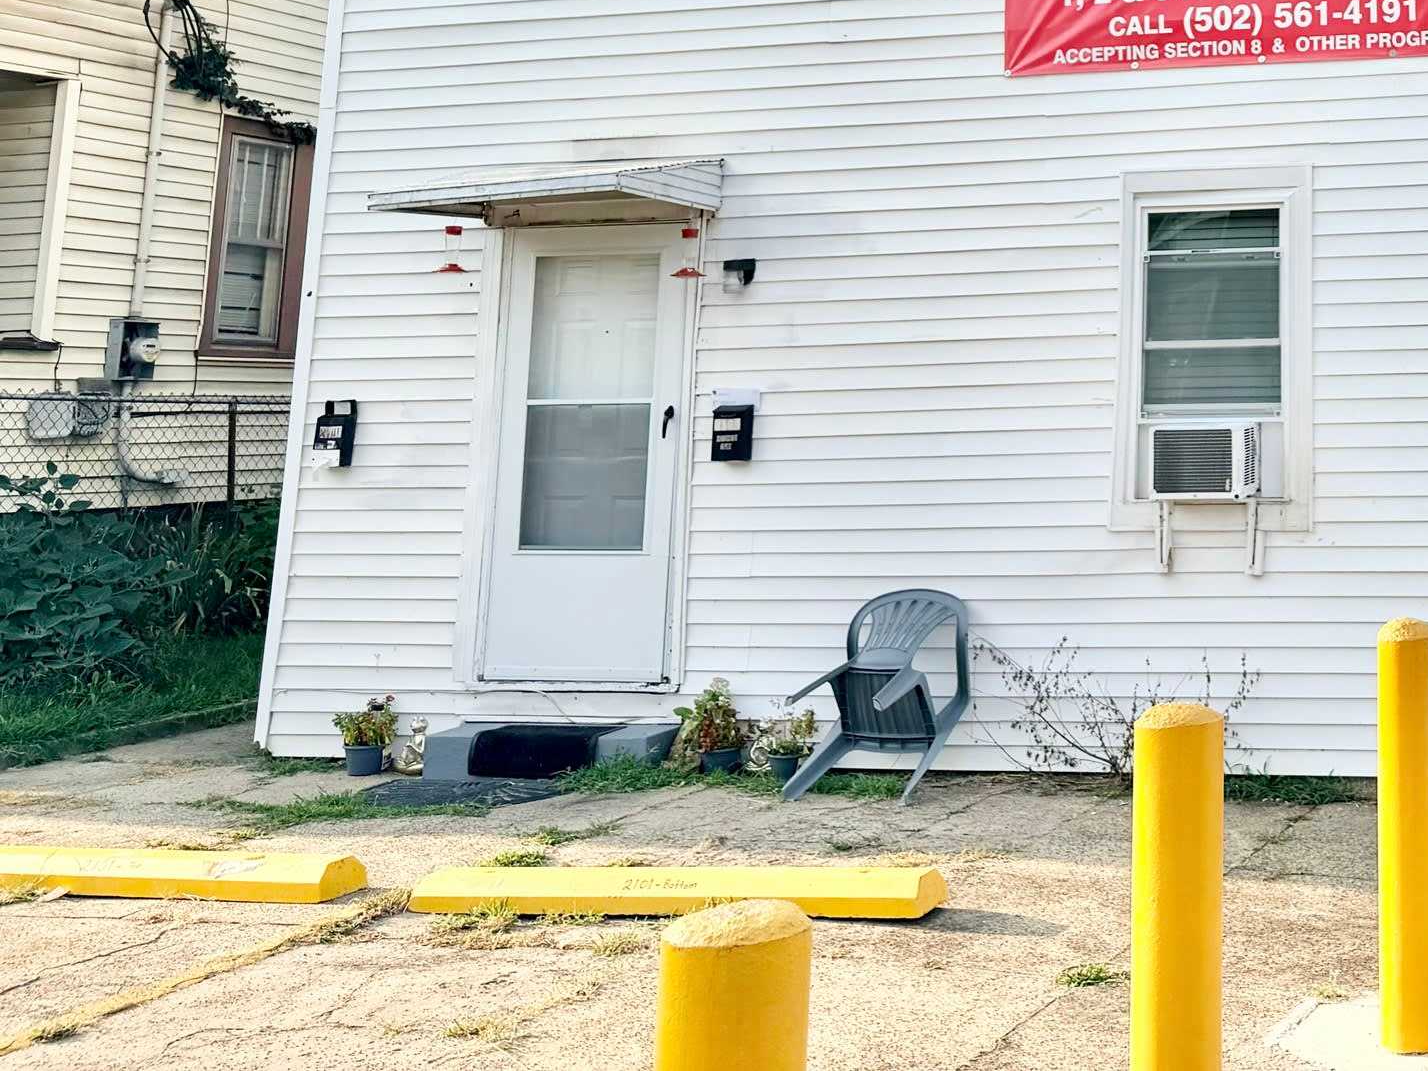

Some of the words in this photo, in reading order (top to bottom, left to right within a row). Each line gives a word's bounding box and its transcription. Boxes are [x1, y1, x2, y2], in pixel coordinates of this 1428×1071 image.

[1108, 14, 1173, 37] CALL
[1183, 2, 1263, 39] (502)
[1052, 43, 1160, 65] ACCEPTING
[1164, 39, 1246, 59] SECTION
[1250, 39, 1262, 54] 8
[1272, 37, 1286, 54] &
[1295, 33, 1361, 52] OTHER
